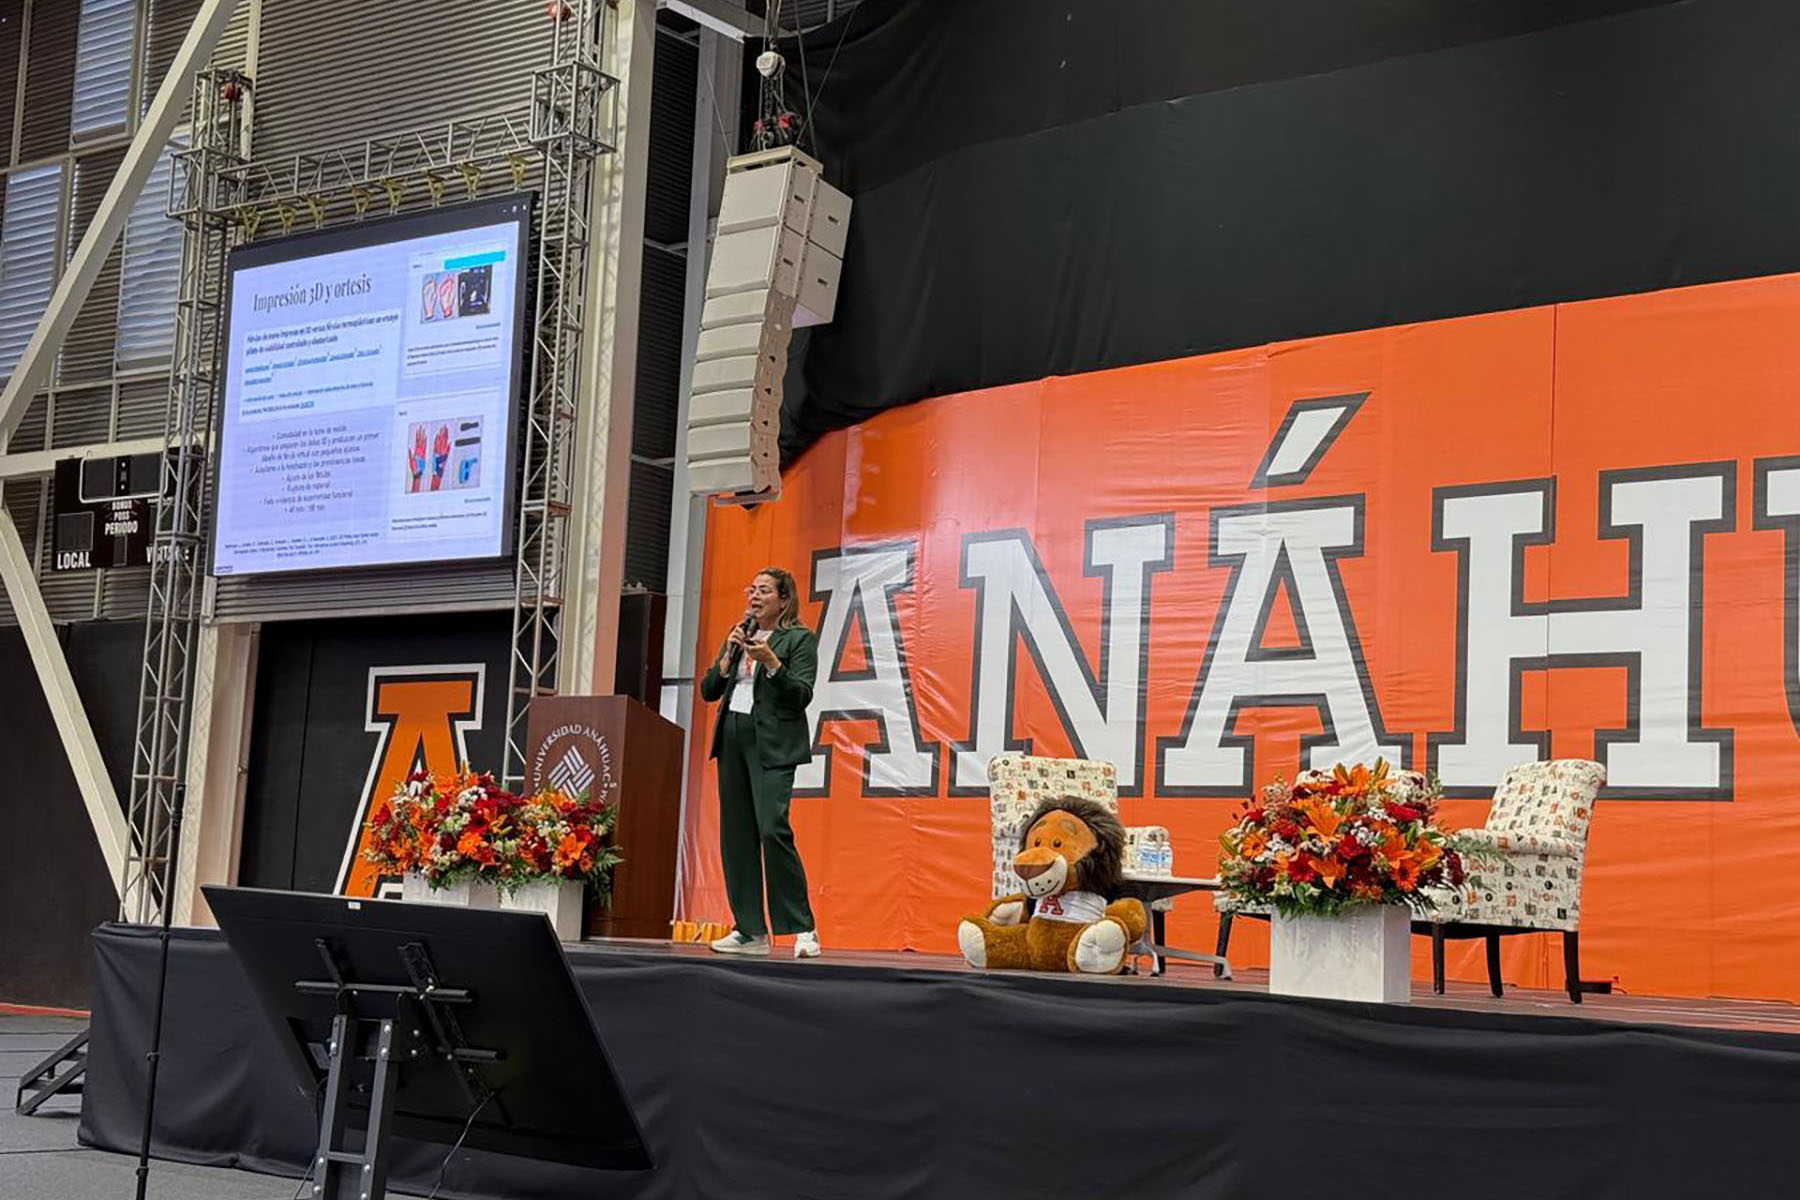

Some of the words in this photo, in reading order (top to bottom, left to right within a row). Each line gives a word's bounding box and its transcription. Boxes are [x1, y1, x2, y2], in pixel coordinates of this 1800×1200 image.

[254, 283, 306, 313] Impresión
[309, 282, 323, 306] 3D
[325, 284, 333, 303] y
[104, 520, 139, 536] PERIODO
[57, 551, 92, 570] LOCAL
[791, 391, 1800, 801] ANÁH
[533, 723, 582, 782] UNIVERSIDAD
